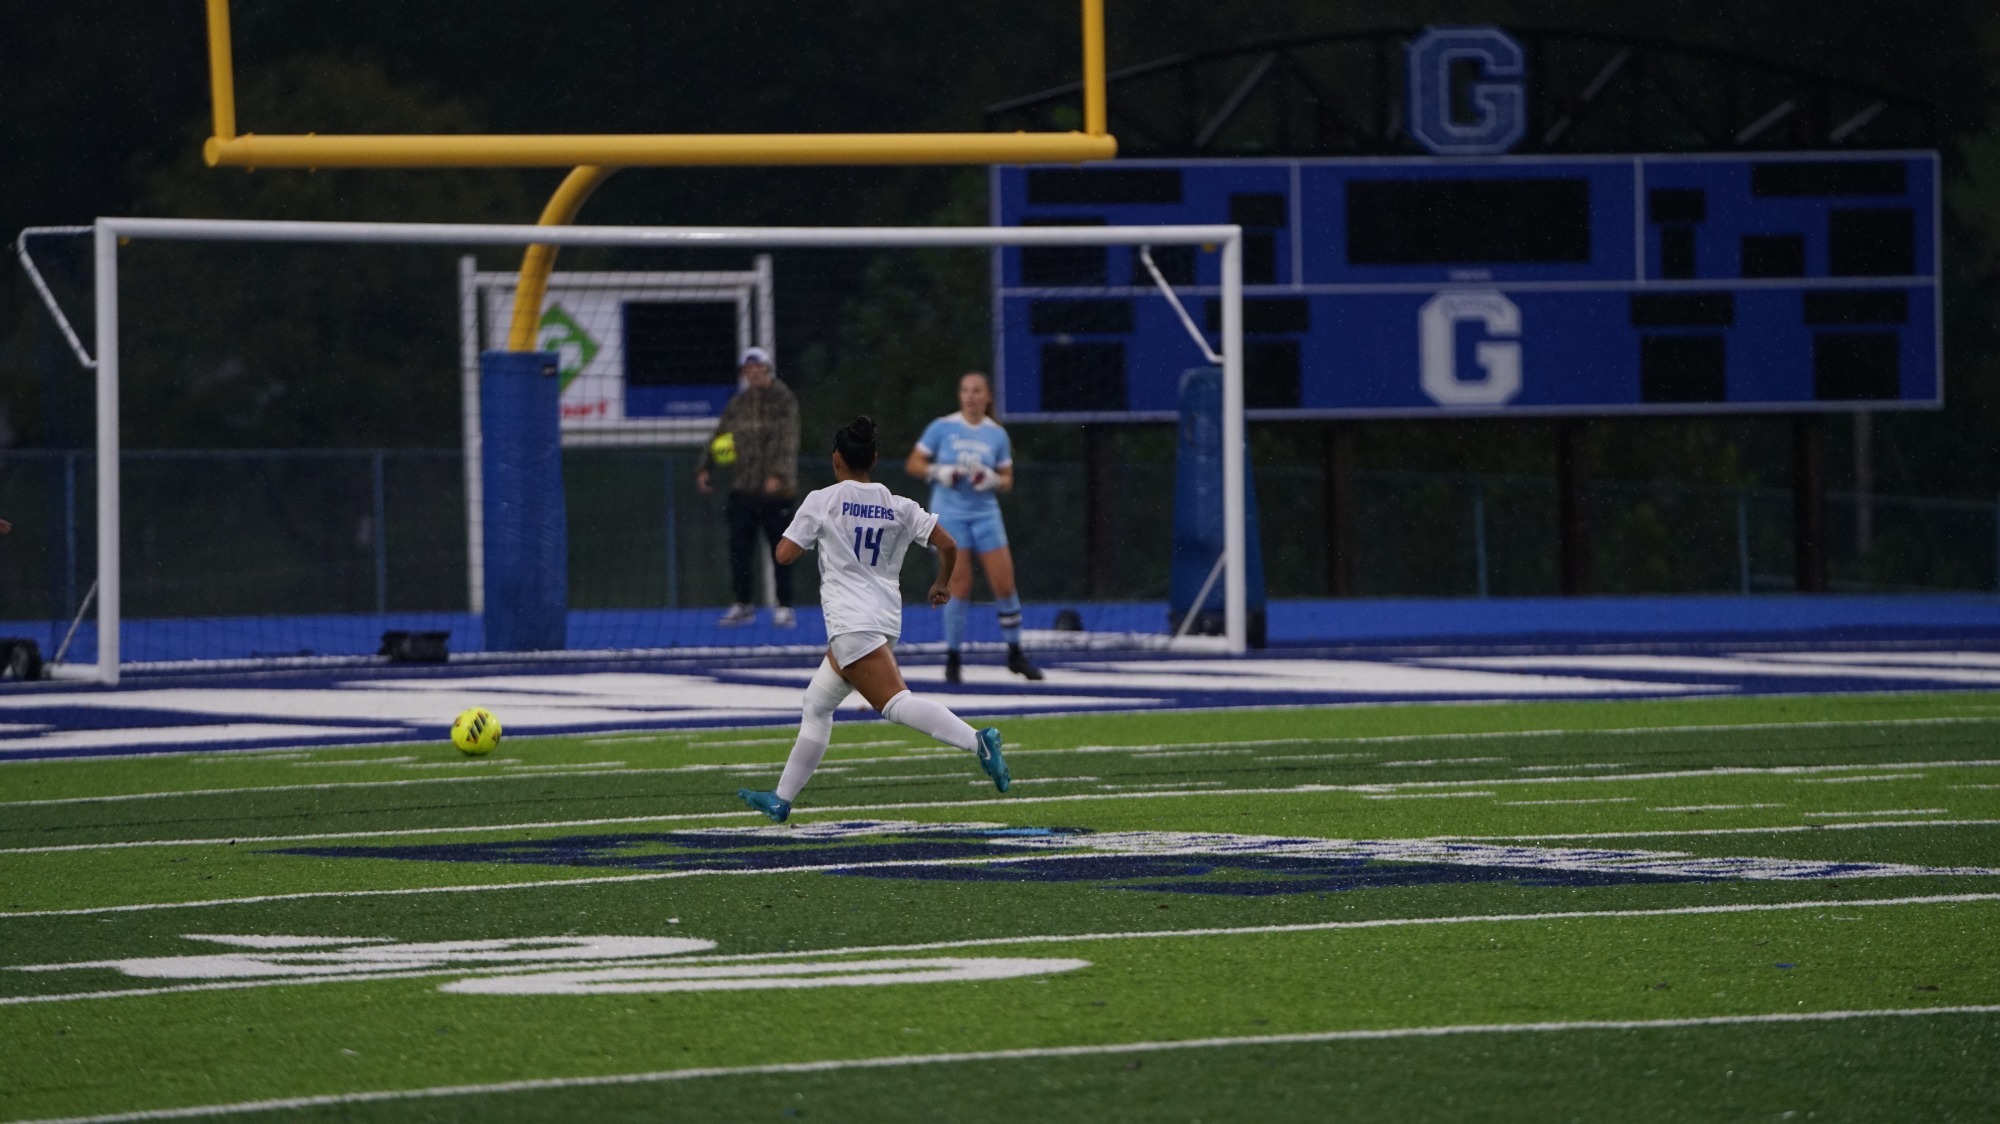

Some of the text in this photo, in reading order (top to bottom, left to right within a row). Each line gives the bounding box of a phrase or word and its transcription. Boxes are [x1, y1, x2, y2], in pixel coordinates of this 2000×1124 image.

[1405, 26, 1527, 155] G
[1418, 290, 1523, 408] G
[842, 502, 895, 521] PIONEERS
[854, 526, 884, 566] 14
